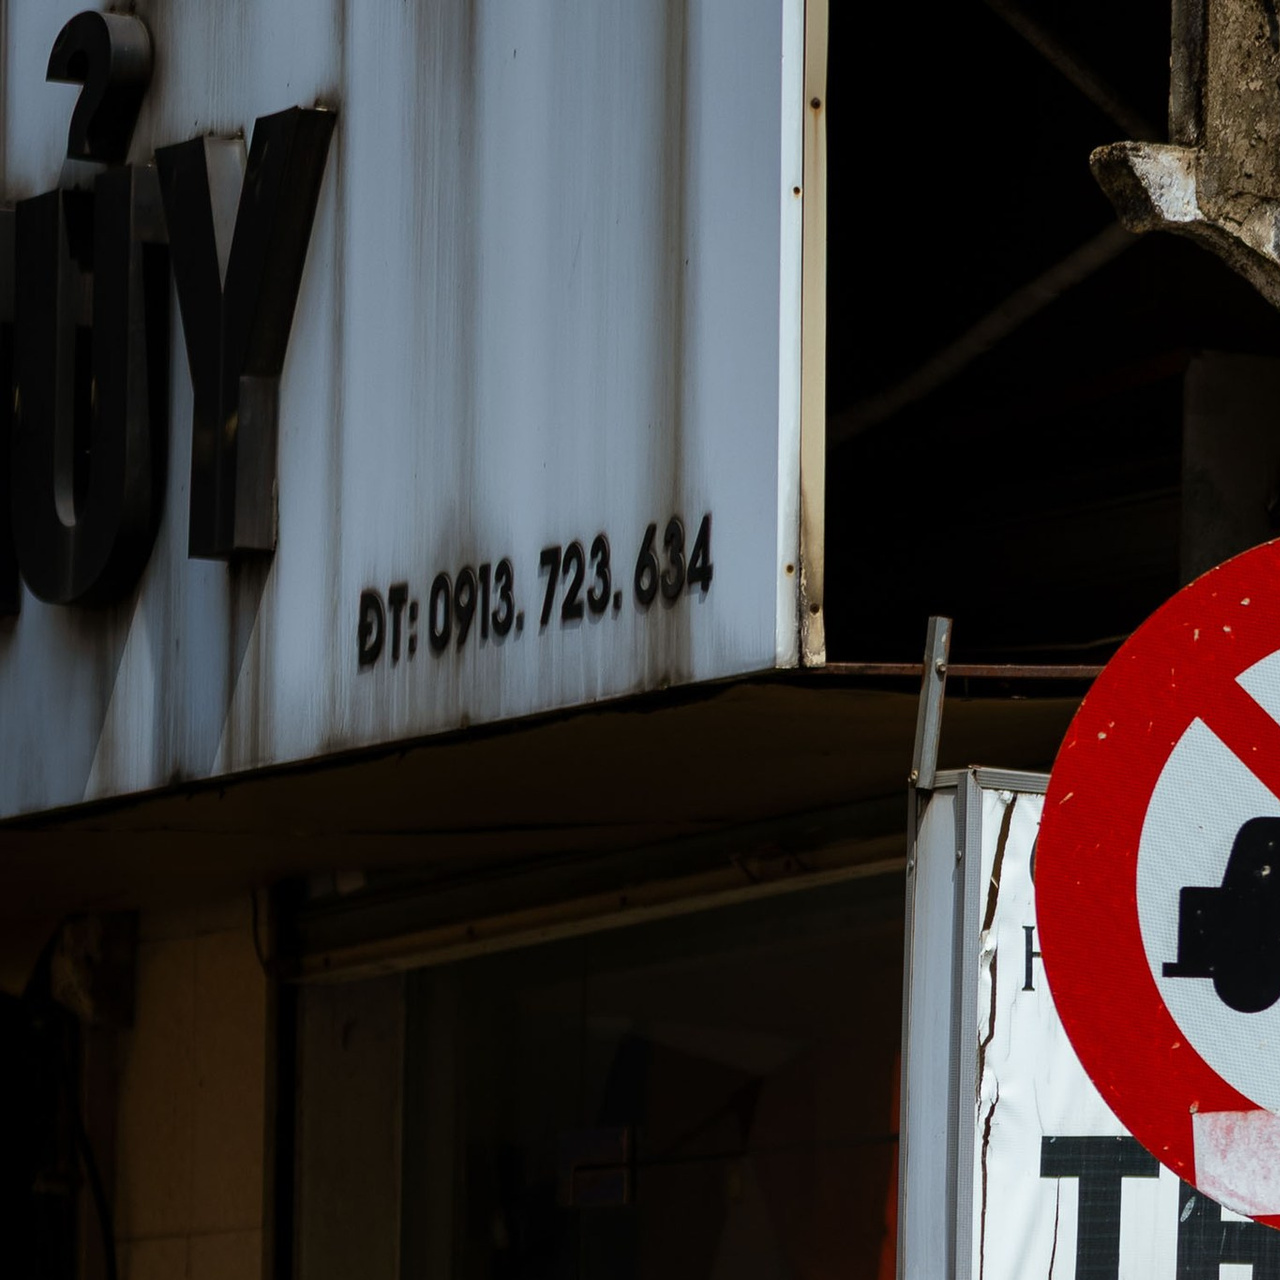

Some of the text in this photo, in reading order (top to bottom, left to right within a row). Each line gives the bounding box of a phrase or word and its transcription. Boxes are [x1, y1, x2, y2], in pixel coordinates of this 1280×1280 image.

[0, 10, 336, 620] ỦY
[358, 513, 714, 670] ĐT: 0913. 723. 634
